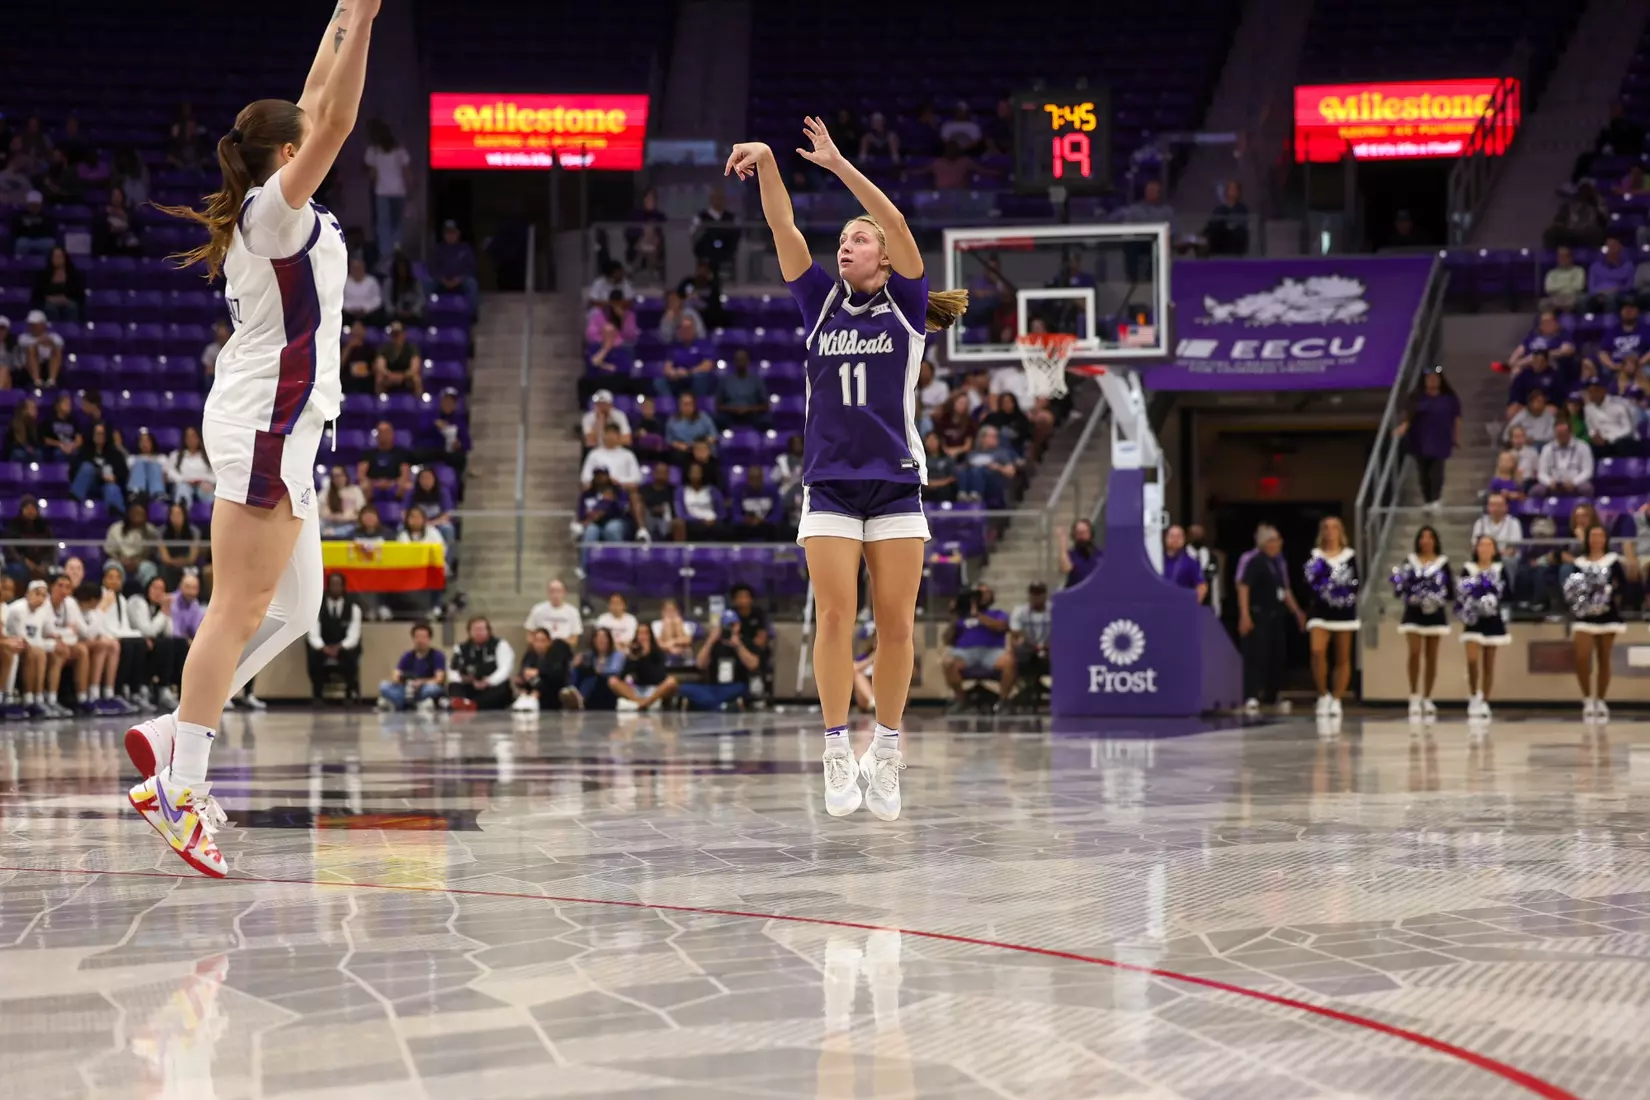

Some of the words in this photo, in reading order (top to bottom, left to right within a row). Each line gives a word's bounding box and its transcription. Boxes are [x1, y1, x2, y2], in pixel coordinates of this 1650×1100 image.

[453, 101, 626, 133] Milestone
[1044, 102, 1097, 131] 7:45
[1319, 91, 1494, 123] Milestone
[1052, 132, 1091, 179] 19
[818, 328, 894, 356] Wildcats
[1230, 336, 1366, 359] EECU
[838, 362, 867, 406] 11
[1087, 664, 1158, 693] Frost
